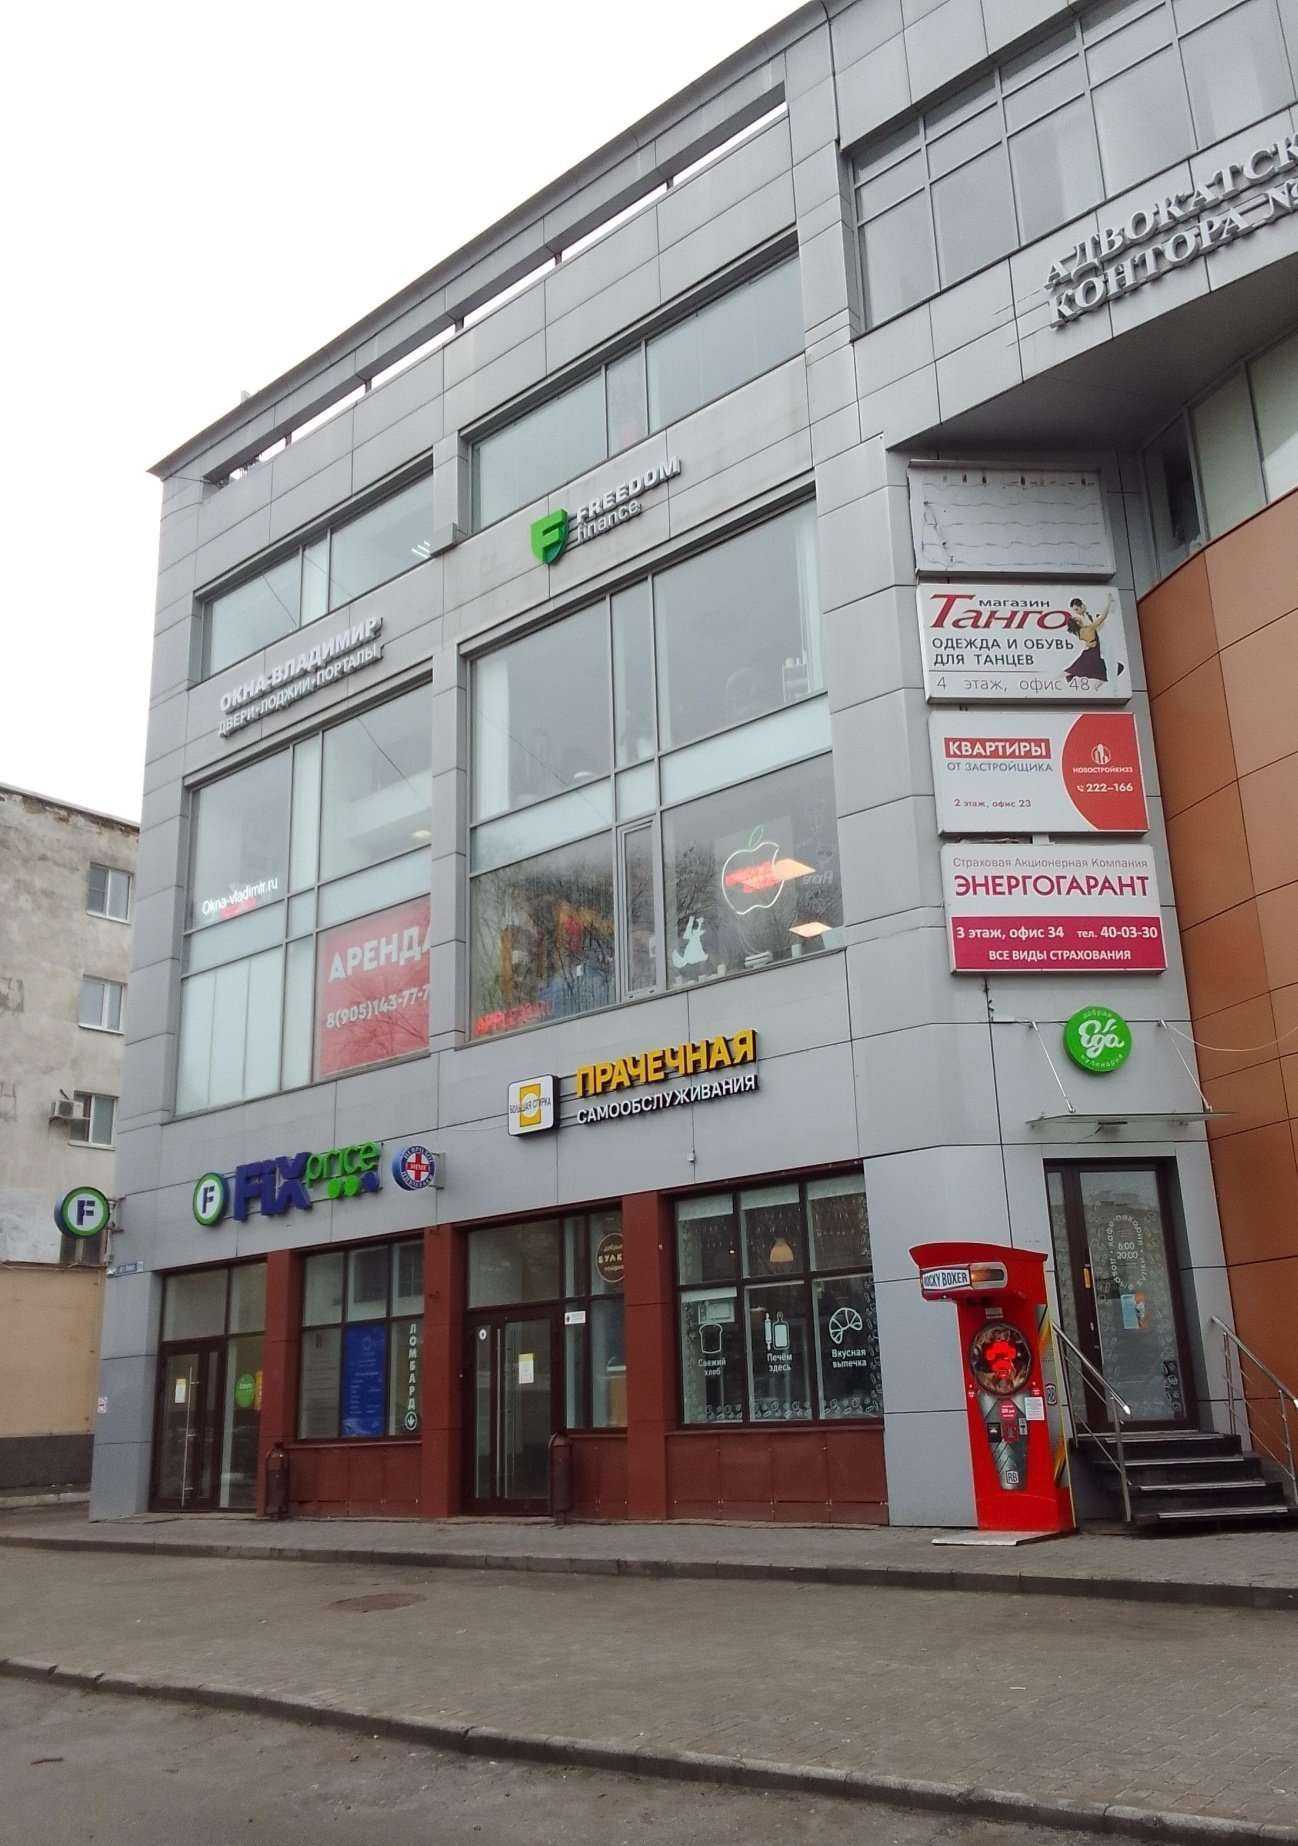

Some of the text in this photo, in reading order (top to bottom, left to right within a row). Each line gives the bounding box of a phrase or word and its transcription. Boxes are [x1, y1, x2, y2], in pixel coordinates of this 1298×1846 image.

[1050, 207, 1246, 329] КОНТОРА
[576, 455, 682, 525] FREEDOM
[576, 499, 642, 544] finance
[978, 599, 1050, 608] магазин
[930, 594, 1072, 629] Танго
[932, 638, 1074, 651] ОДЕЖДА И ОБУВЬ
[933, 654, 1034, 667] ДЛЯ ТАНЦЕВ
[936, 676, 946, 690] 4
[1019, 677, 1063, 694] офис
[1068, 676, 1090, 691] 48
[949, 741, 1046, 756] КВАРТИРЫ
[946, 761, 1053, 773] ОТ ЗАСТРОЙЩИКА
[1086, 783, 1133, 793] 222-166
[954, 799, 961, 807] 2
[992, 800, 1016, 809] офис
[1018, 799, 1031, 807] 23
[953, 857, 1148, 869] Страховая Акционерная Компания
[954, 875, 1149, 896] ЭНЕРГОГАРАНТ
[956, 926, 1158, 941] 3 этаж, офис 34 тел. 40-03-30
[989, 950, 1131, 962] ВСЕ ВИДЫ СТРАХОВАНИЯ
[575, 1029, 757, 1098] ПРАЧЕЧНАЯ
[576, 1073, 757, 1124] САМООБСЛУЖИВАНИЯ
[941, 1272, 968, 1286] BOXER
[832, 1349, 867, 1359] Вкусная
[407, 1323, 417, 1410] ЛОМБАРД
[768, 1364, 792, 1373] здесь
